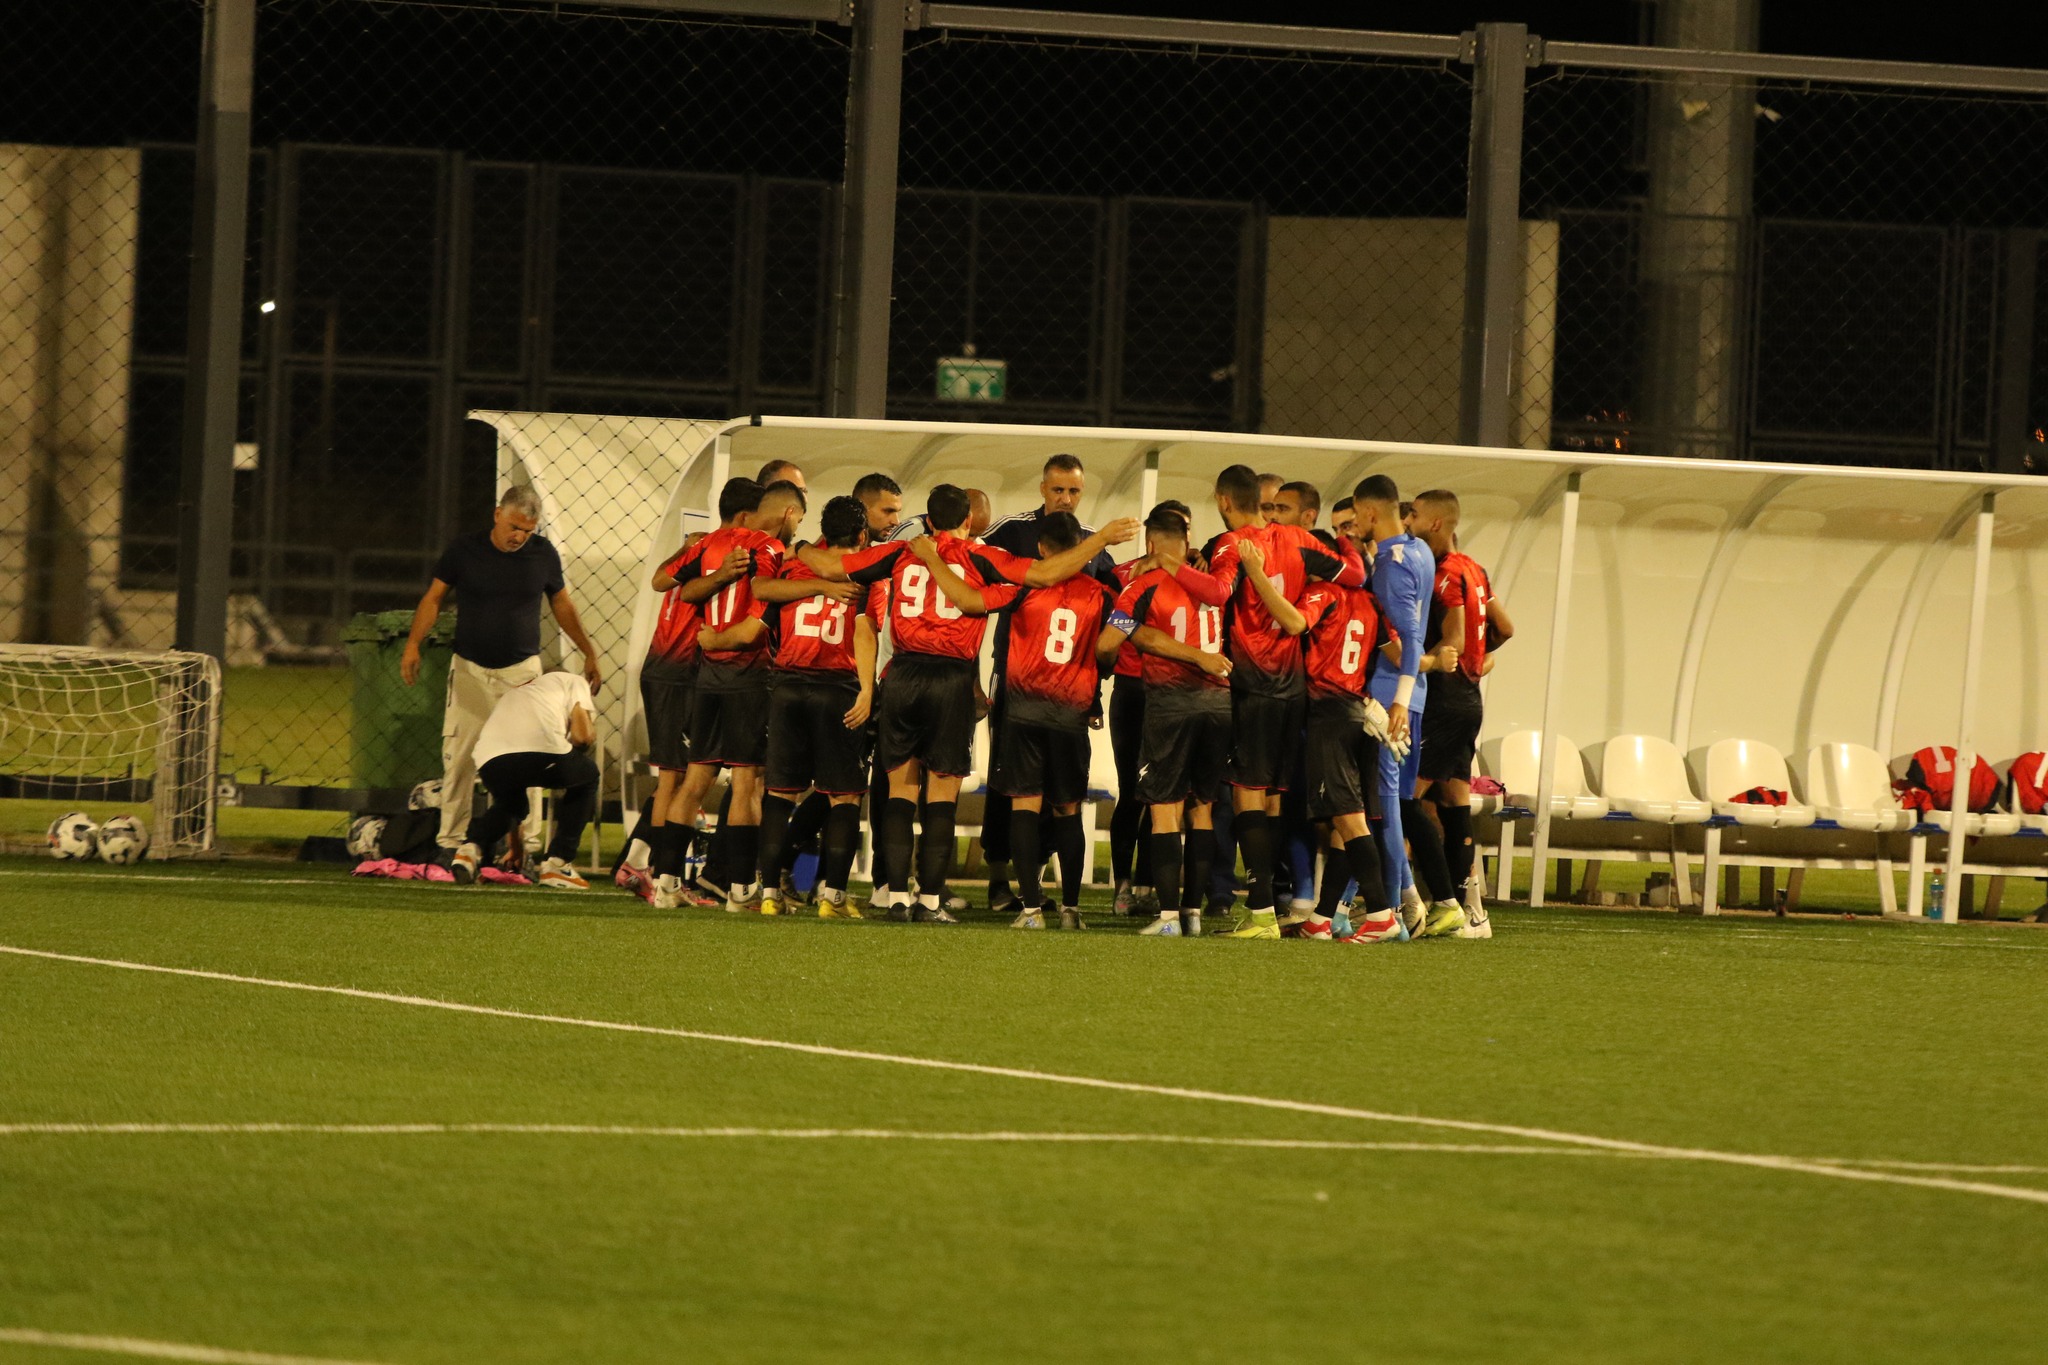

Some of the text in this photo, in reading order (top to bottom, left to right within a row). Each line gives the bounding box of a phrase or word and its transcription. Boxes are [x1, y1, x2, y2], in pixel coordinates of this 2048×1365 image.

[794, 594, 850, 645] 23
[900, 563, 966, 620] 90
[1044, 607, 1077, 664] 8
[1170, 601, 1222, 654] 10
[1340, 619, 1364, 675] 6
